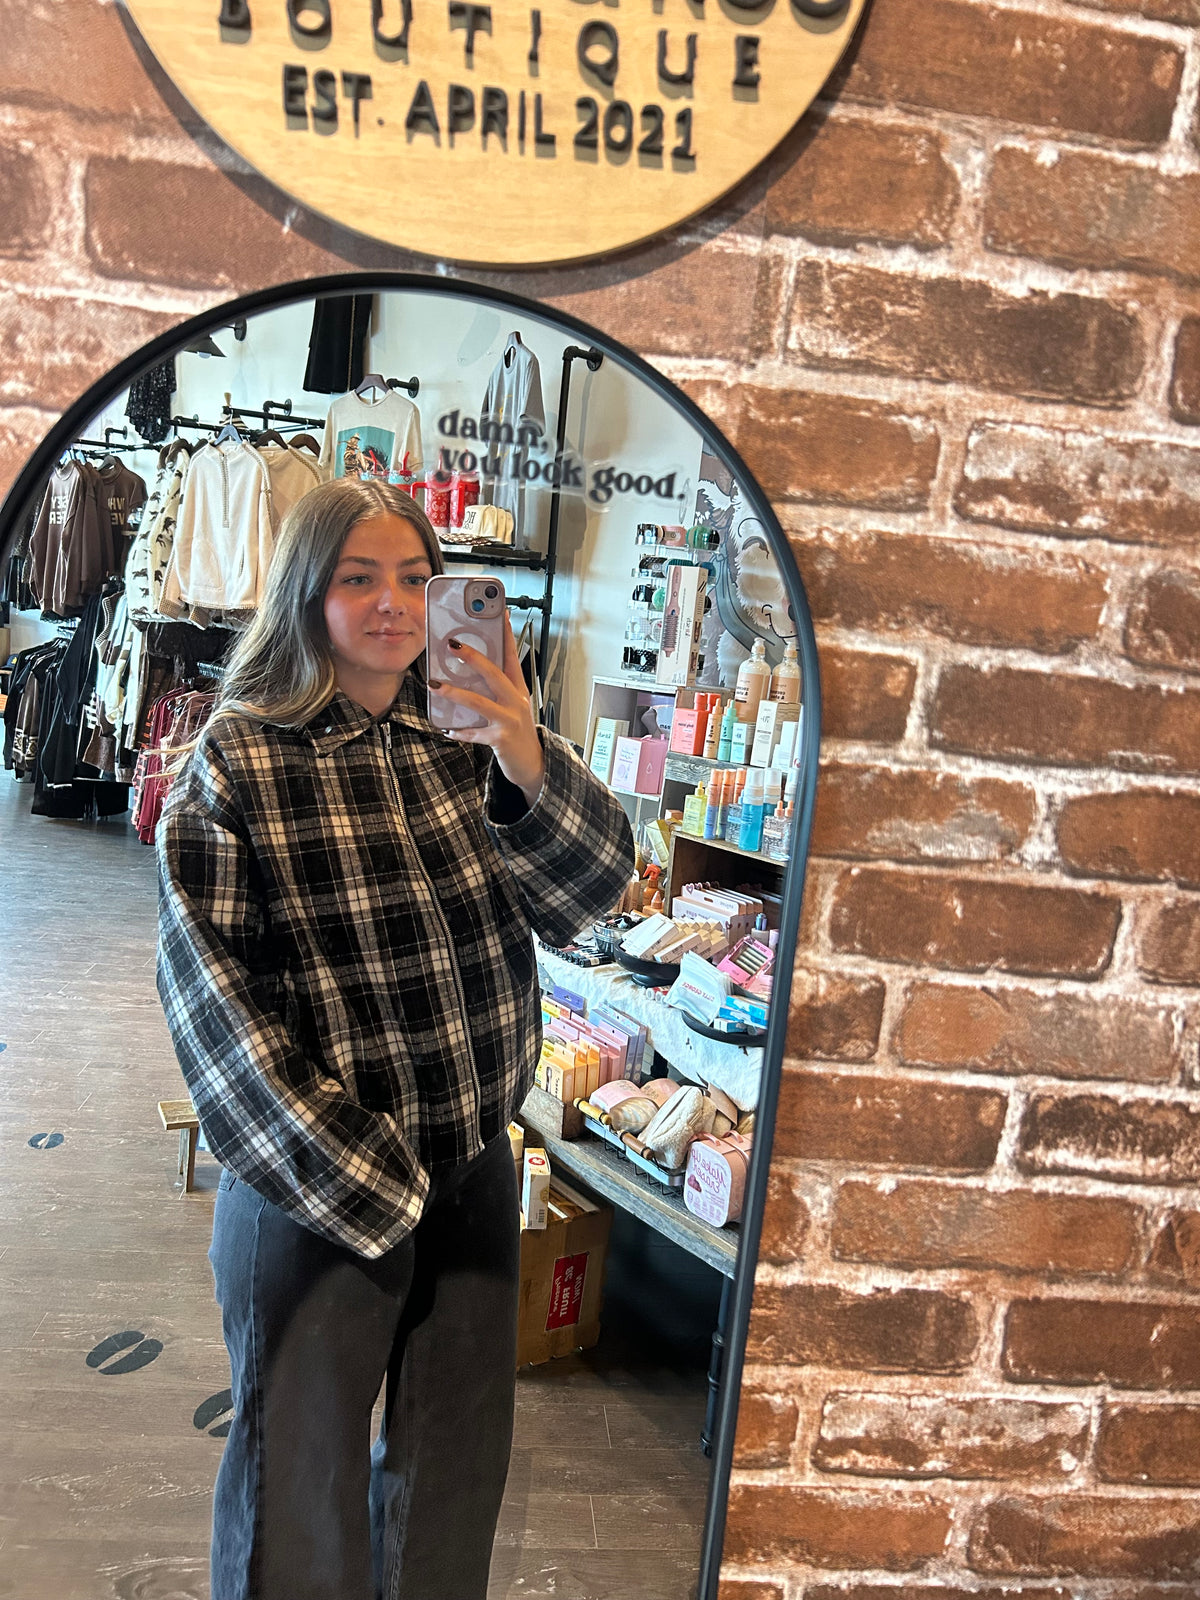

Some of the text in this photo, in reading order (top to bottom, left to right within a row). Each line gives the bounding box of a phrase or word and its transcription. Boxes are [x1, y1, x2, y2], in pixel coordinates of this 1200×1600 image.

[283, 63, 697, 160] EST. APRIL 2021
[437, 409, 548, 454] damn,
[434, 448, 686, 504] you look good.
